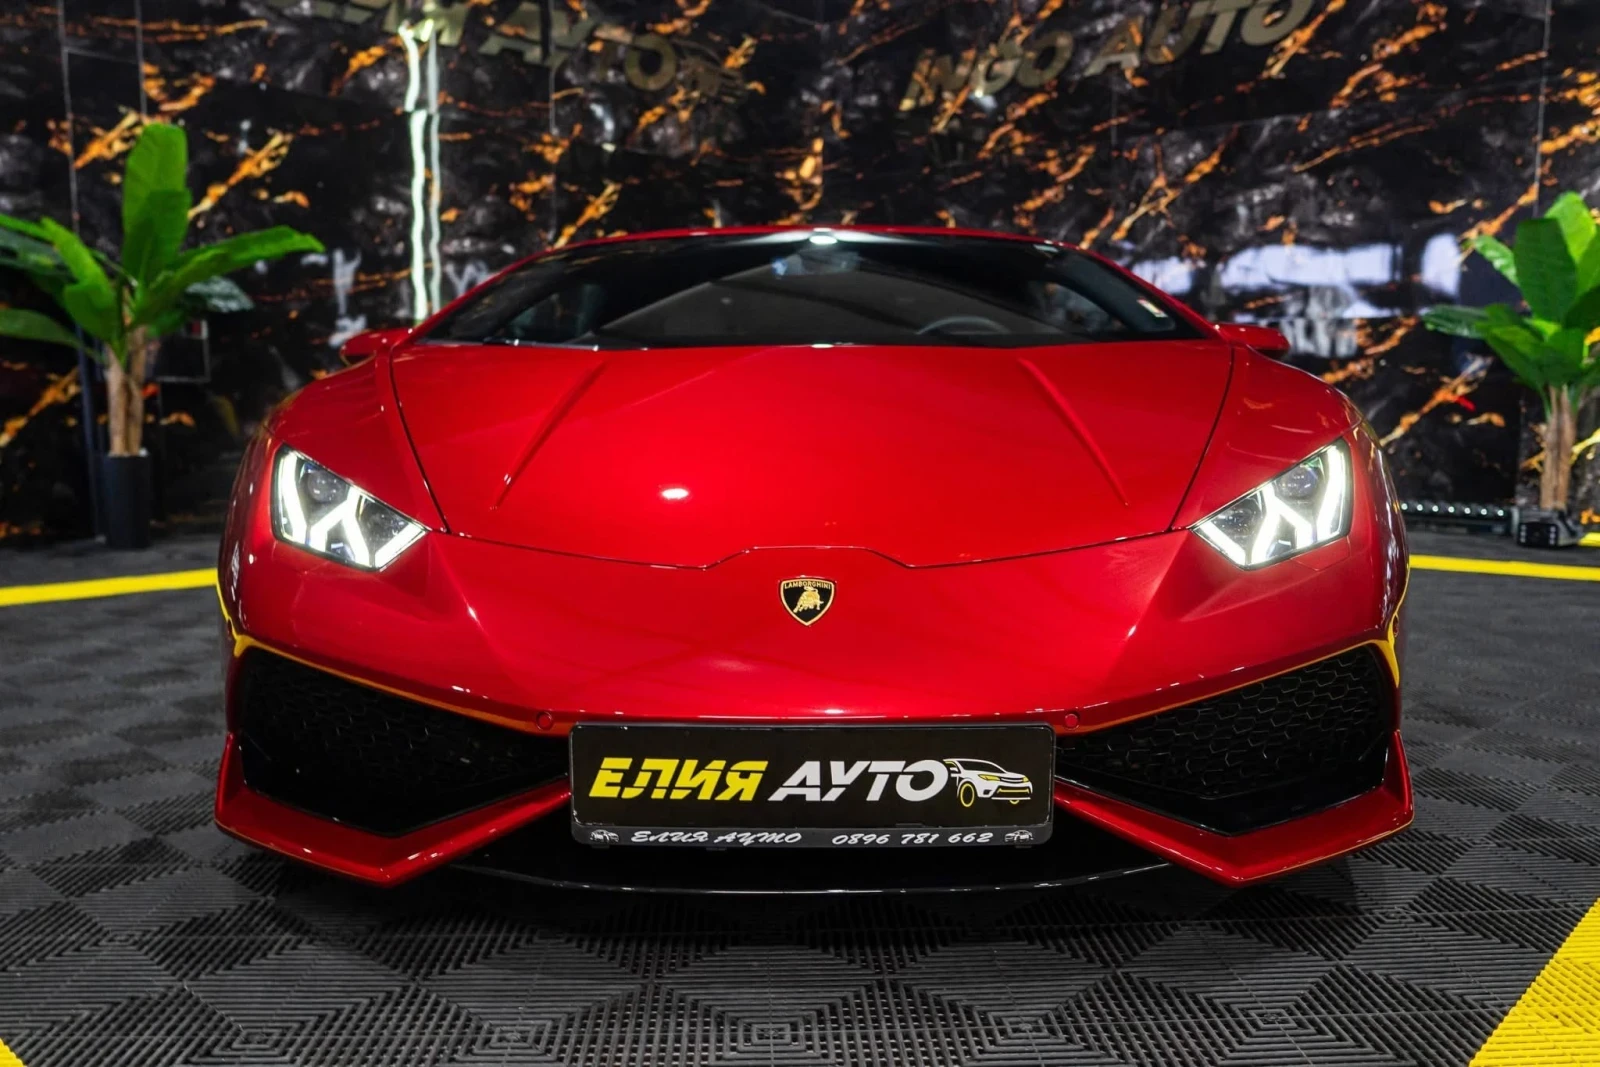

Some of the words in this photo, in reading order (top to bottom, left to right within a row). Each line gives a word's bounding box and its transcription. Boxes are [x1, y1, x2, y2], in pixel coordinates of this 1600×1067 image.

[1086, 0, 1314, 77] AUTO
[784, 581, 831, 590] LAMBORGHINI
[588, 757, 769, 801] ЕЛИЯ
[767, 759, 949, 802] АУТО
[831, 833, 891, 845] 0896
[900, 832, 940, 845] 781
[947, 832, 994, 844] 662
